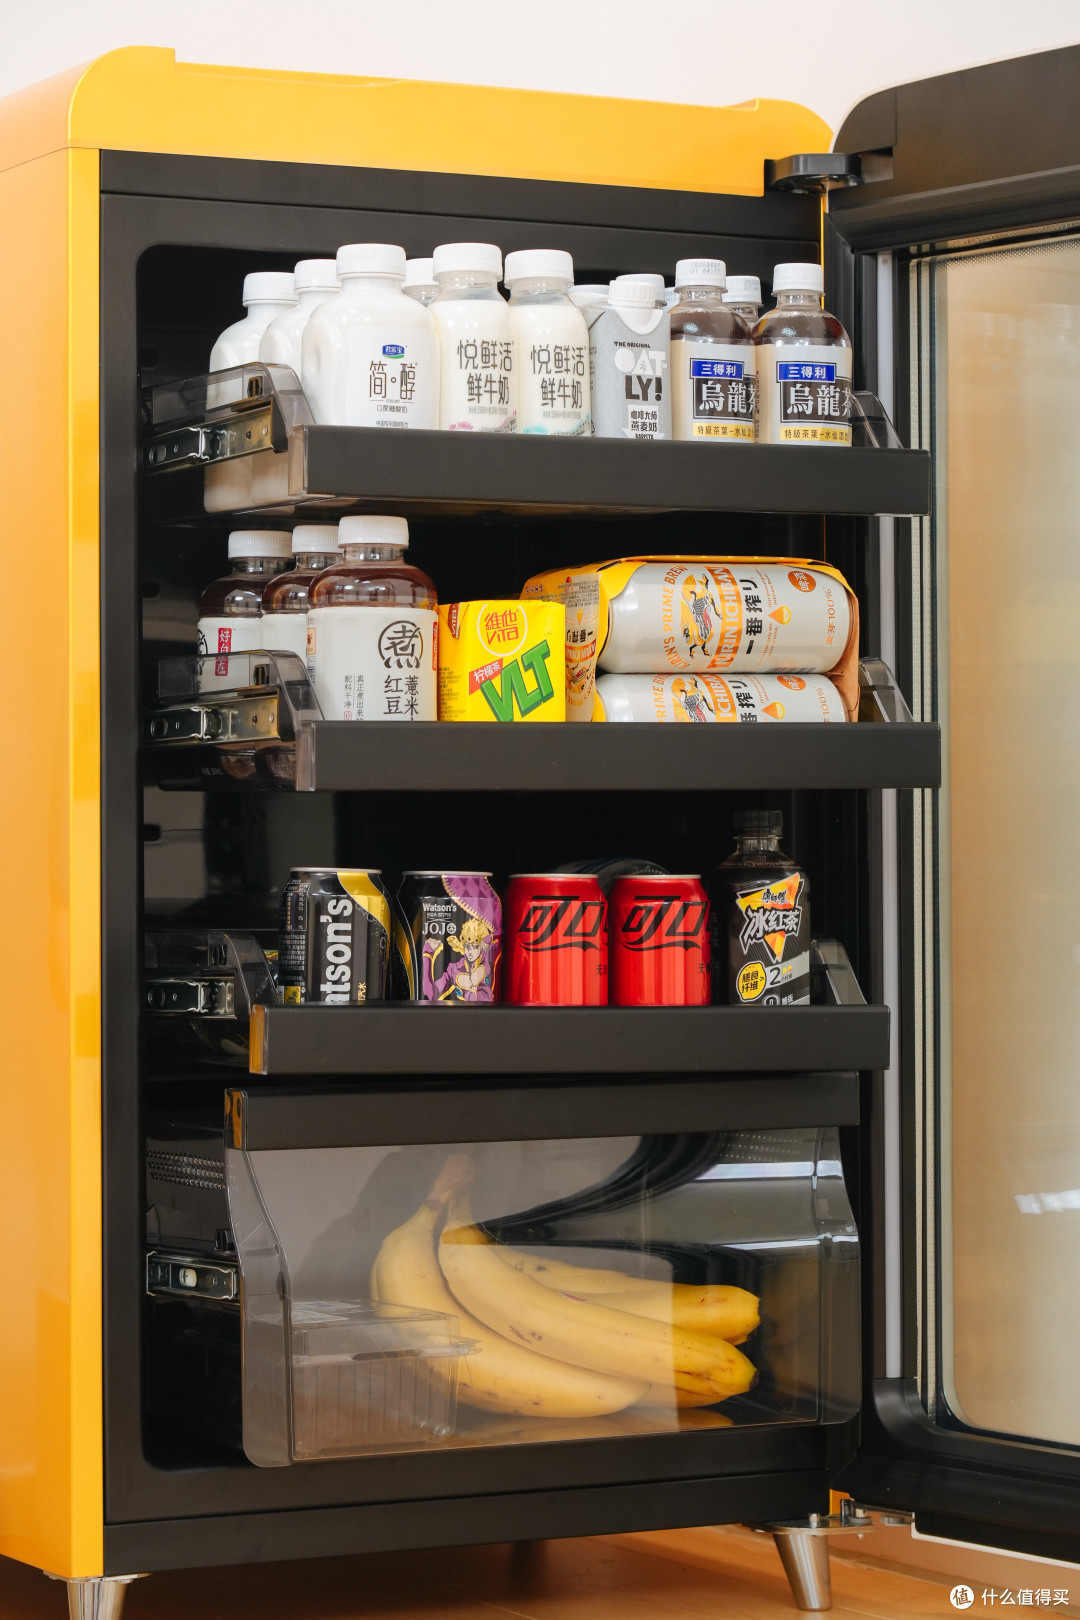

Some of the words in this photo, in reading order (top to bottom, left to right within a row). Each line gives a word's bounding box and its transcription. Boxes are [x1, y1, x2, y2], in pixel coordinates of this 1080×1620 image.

[458, 339, 512, 371] 悦鲜活
[531, 344, 584, 376] 悦鲜活
[701, 364, 736, 376] 三得利
[788, 366, 826, 379] 三得利
[467, 373, 509, 404] 鲜牛奶
[541, 378, 582, 408] 鲜牛奶
[625, 375, 662, 401] LY!
[631, 421, 657, 431] 燕麦奶
[664, 565, 687, 585] BREW
[793, 572, 810, 591] 啤酒
[663, 586, 674, 631] PRIME
[713, 567, 737, 622] ICHIBAN
[485, 610, 517, 631] 維他
[740, 579, 762, 654] 一番搾り
[384, 624, 420, 669] 煮
[664, 636, 690, 669] KIRIN'S
[715, 627, 737, 664] KIRIN
[474, 661, 500, 683] 柠檬茶
[344, 675, 353, 709] 配料干净
[383, 675, 403, 715] 红豆
[404, 675, 419, 720] 薏米
[423, 903, 457, 911] Watson's
[744, 907, 800, 943] 冰红茶
[741, 981, 759, 994] 纤维
[742, 970, 759, 983] 膳食
[769, 967, 781, 986] 2
